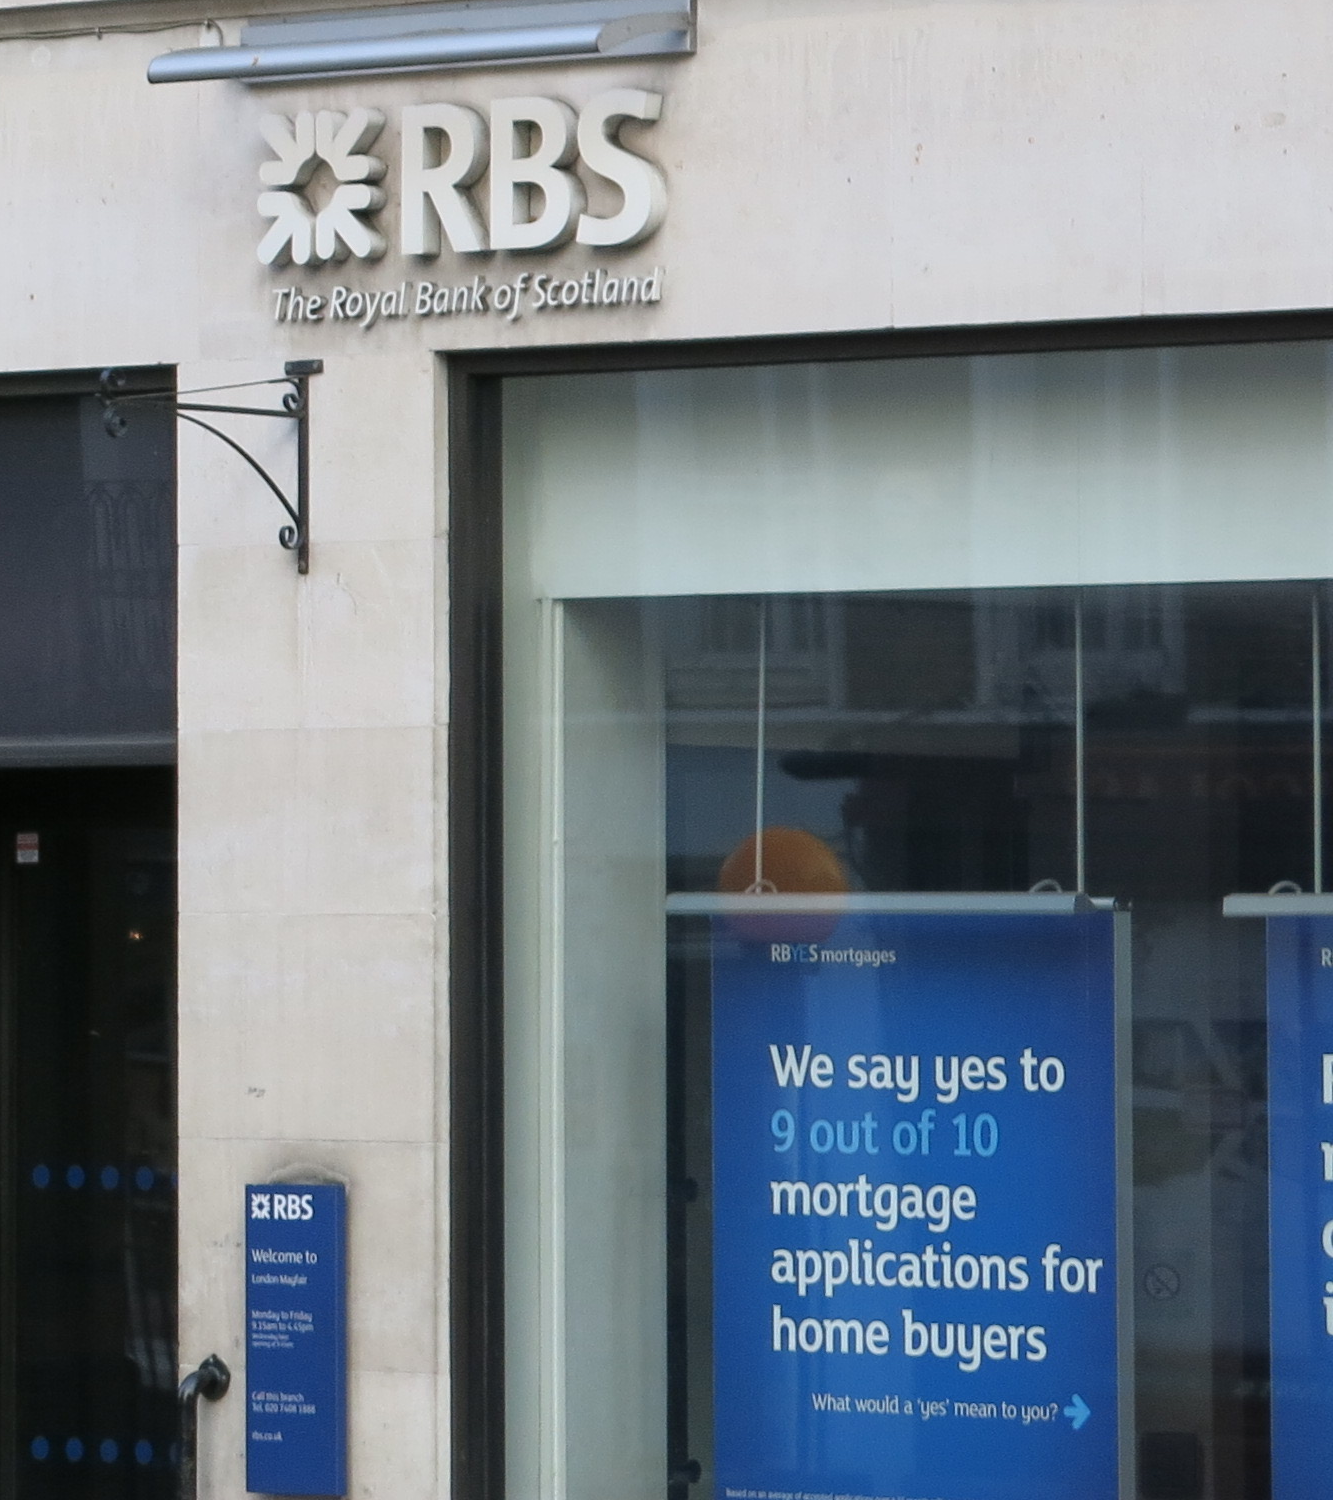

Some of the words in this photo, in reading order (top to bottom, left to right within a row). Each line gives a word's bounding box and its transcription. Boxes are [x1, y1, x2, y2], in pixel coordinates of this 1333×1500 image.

[401, 88, 667, 258] RBS
[271, 287, 323, 321] The
[330, 282, 408, 329] Royal
[414, 274, 489, 316] Bank
[493, 272, 531, 321] of
[532, 266, 663, 308] Scotland
[820, 947, 898, 968] mortgages
[768, 1043, 835, 1089] We
[846, 1053, 920, 1104] say
[934, 1055, 1008, 1104] yes
[1019, 1048, 1066, 1093] to
[771, 1108, 796, 1153] 9
[808, 1111, 880, 1155] out
[891, 1109, 935, 1156] of
[951, 1112, 999, 1157] 10
[273, 1193, 314, 1220] RBS
[769, 1174, 977, 1233] mortgage
[251, 1248, 303, 1264] Welcome
[305, 1250, 318, 1264] to
[770, 1238, 1030, 1298] applications
[1040, 1243, 1104, 1294] for
[772, 1304, 891, 1356] home
[900, 1308, 1048, 1373] buyers
[811, 1392, 851, 1413] What
[854, 1394, 900, 1415] would
[903, 1400, 914, 1416] a
[953, 1402, 998, 1419] mean
[1001, 1400, 1018, 1420] to
[1021, 1402, 1059, 1426] you?
